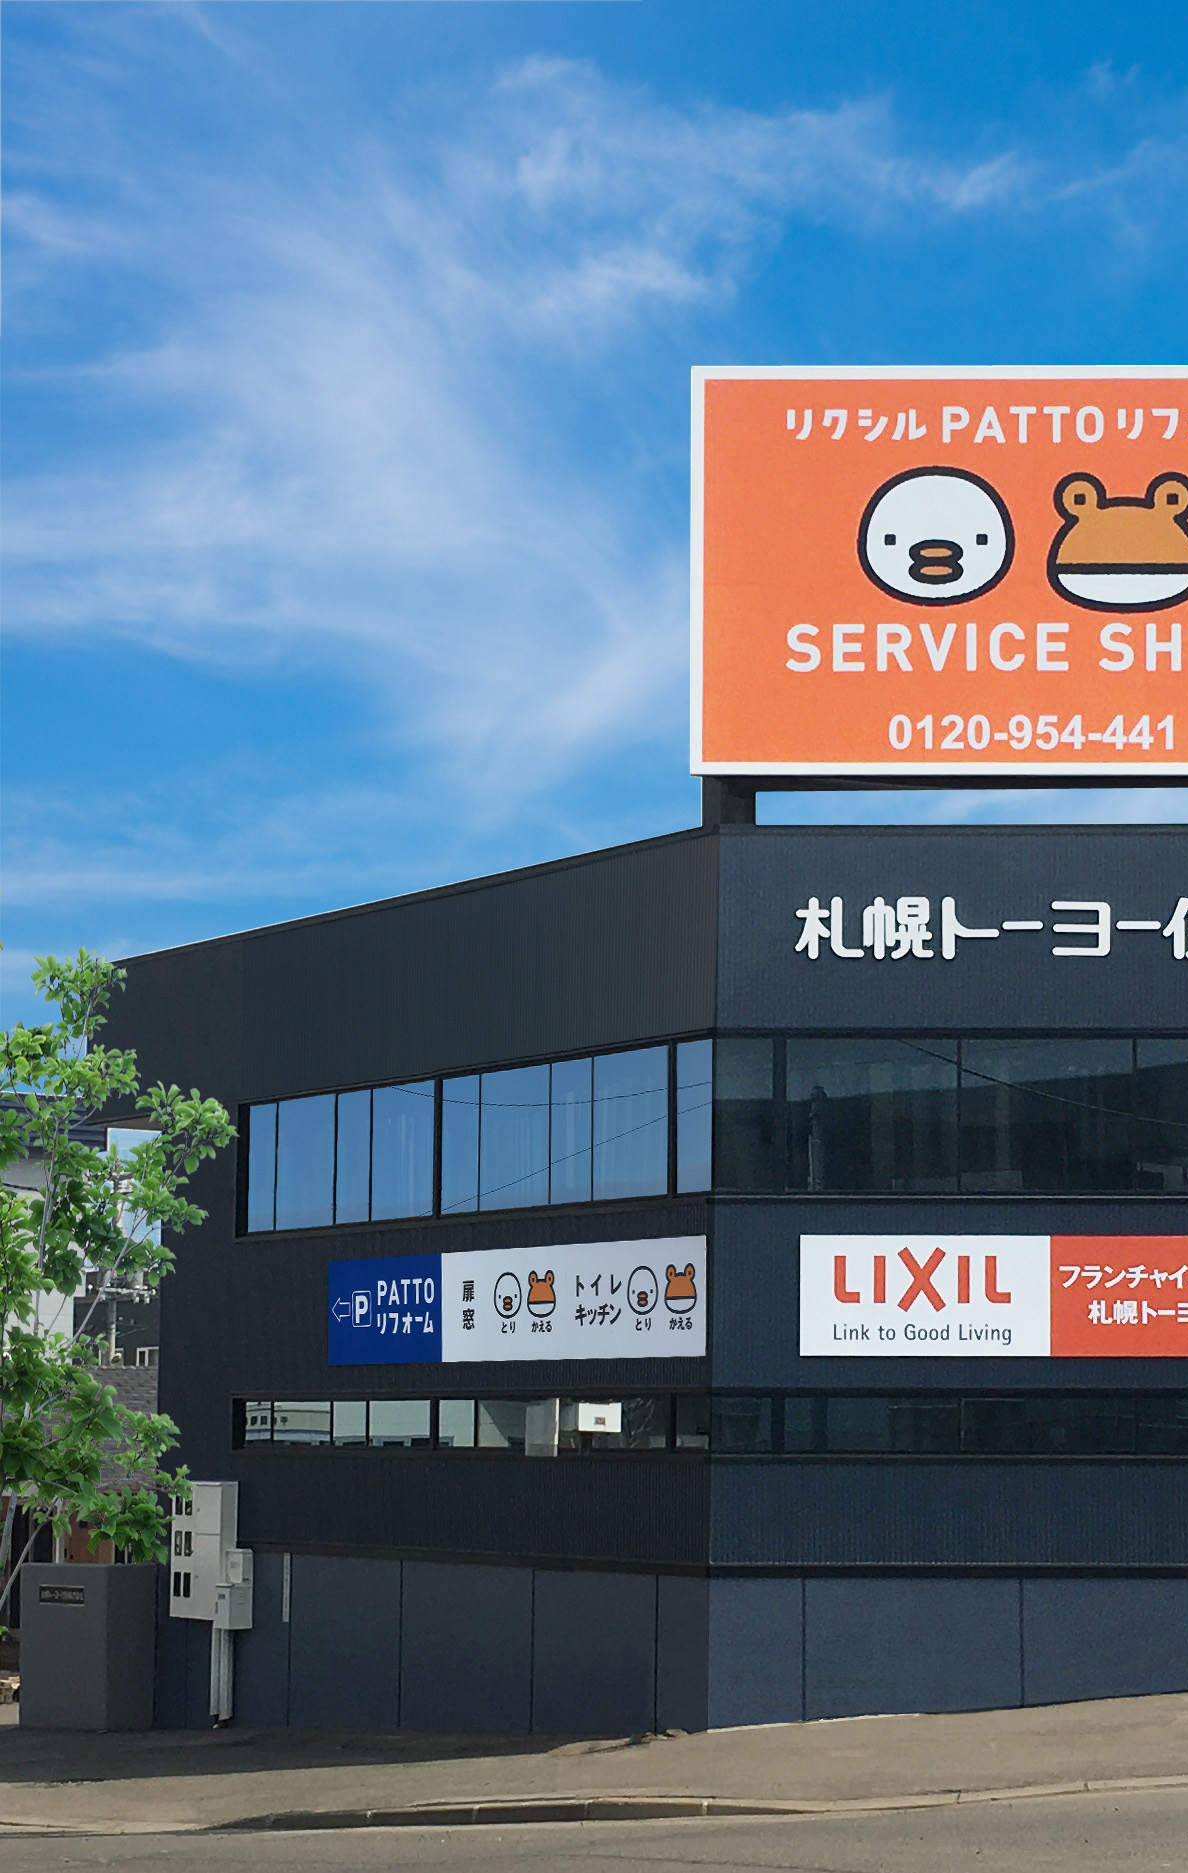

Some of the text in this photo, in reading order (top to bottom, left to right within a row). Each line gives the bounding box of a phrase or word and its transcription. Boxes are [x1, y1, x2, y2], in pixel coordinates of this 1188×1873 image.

[787, 408, 927, 441] リクシル
[943, 406, 1101, 443] PATTO
[786, 623, 1069, 672] SERVICE
[889, 714, 1175, 750] 0120-954-441
[575, 1273, 622, 1297] トイレ
[833, 1246, 1012, 1312] LIXIL
[377, 1278, 434, 1306] PATTO
[463, 1280, 475, 1302] 扉
[354, 1294, 370, 1323] P
[463, 1308, 475, 1331] 窓
[575, 1303, 622, 1327] キッチン
[377, 1312, 434, 1335] リフォーム
[501, 1320, 516, 1334] とり
[531, 1320, 553, 1334] かえる
[635, 1317, 652, 1332] とり
[669, 1316, 693, 1330] かえる
[833, 1322, 1012, 1345] Link to Good Living
